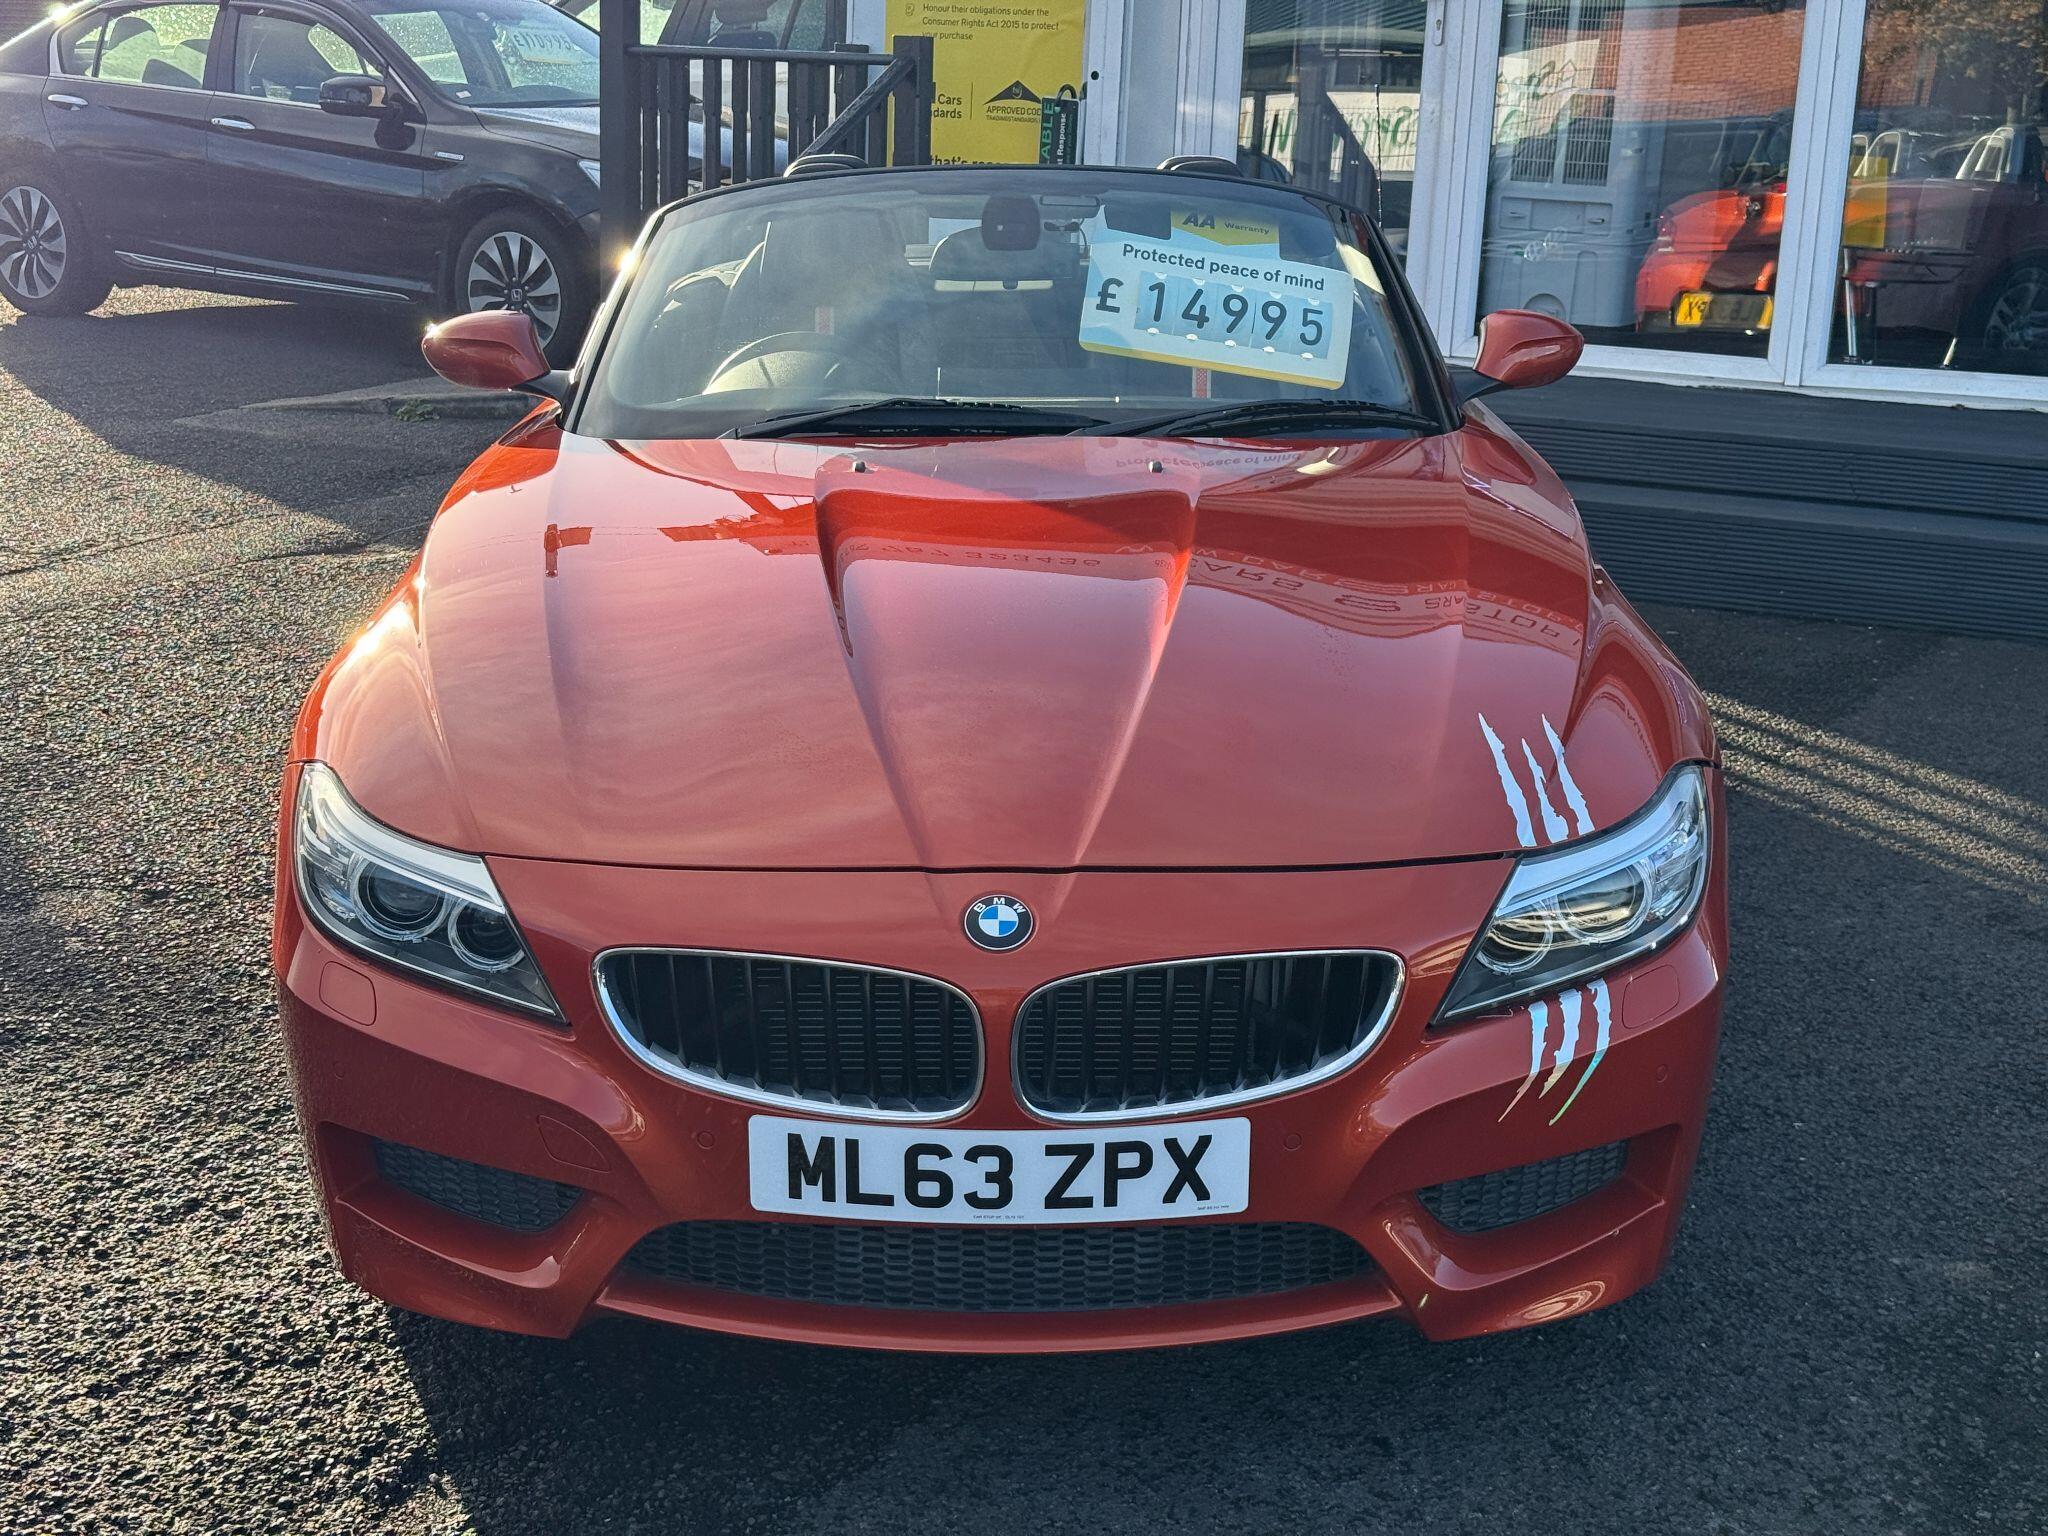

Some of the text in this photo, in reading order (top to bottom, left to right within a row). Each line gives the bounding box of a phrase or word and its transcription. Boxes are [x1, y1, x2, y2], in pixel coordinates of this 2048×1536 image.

[923, 3, 1050, 17] Honour their obligations under the
[922, 17, 1059, 31] Consumer Rights Act 2015 to protect
[939, 32, 974, 41] purchase
[937, 93, 963, 106] Cars
[932, 107, 963, 119] dards
[986, 105, 1026, 116] APPROVED
[1057, 112, 1068, 156] Response
[1183, 211, 1271, 235] AA Warranty
[1122, 243, 1325, 291] Protected peace of mind
[1095, 277, 1324, 346] £ 14995
[973, 896, 1027, 914] BMW
[787, 1132, 1213, 1211] ML63 ZPX
